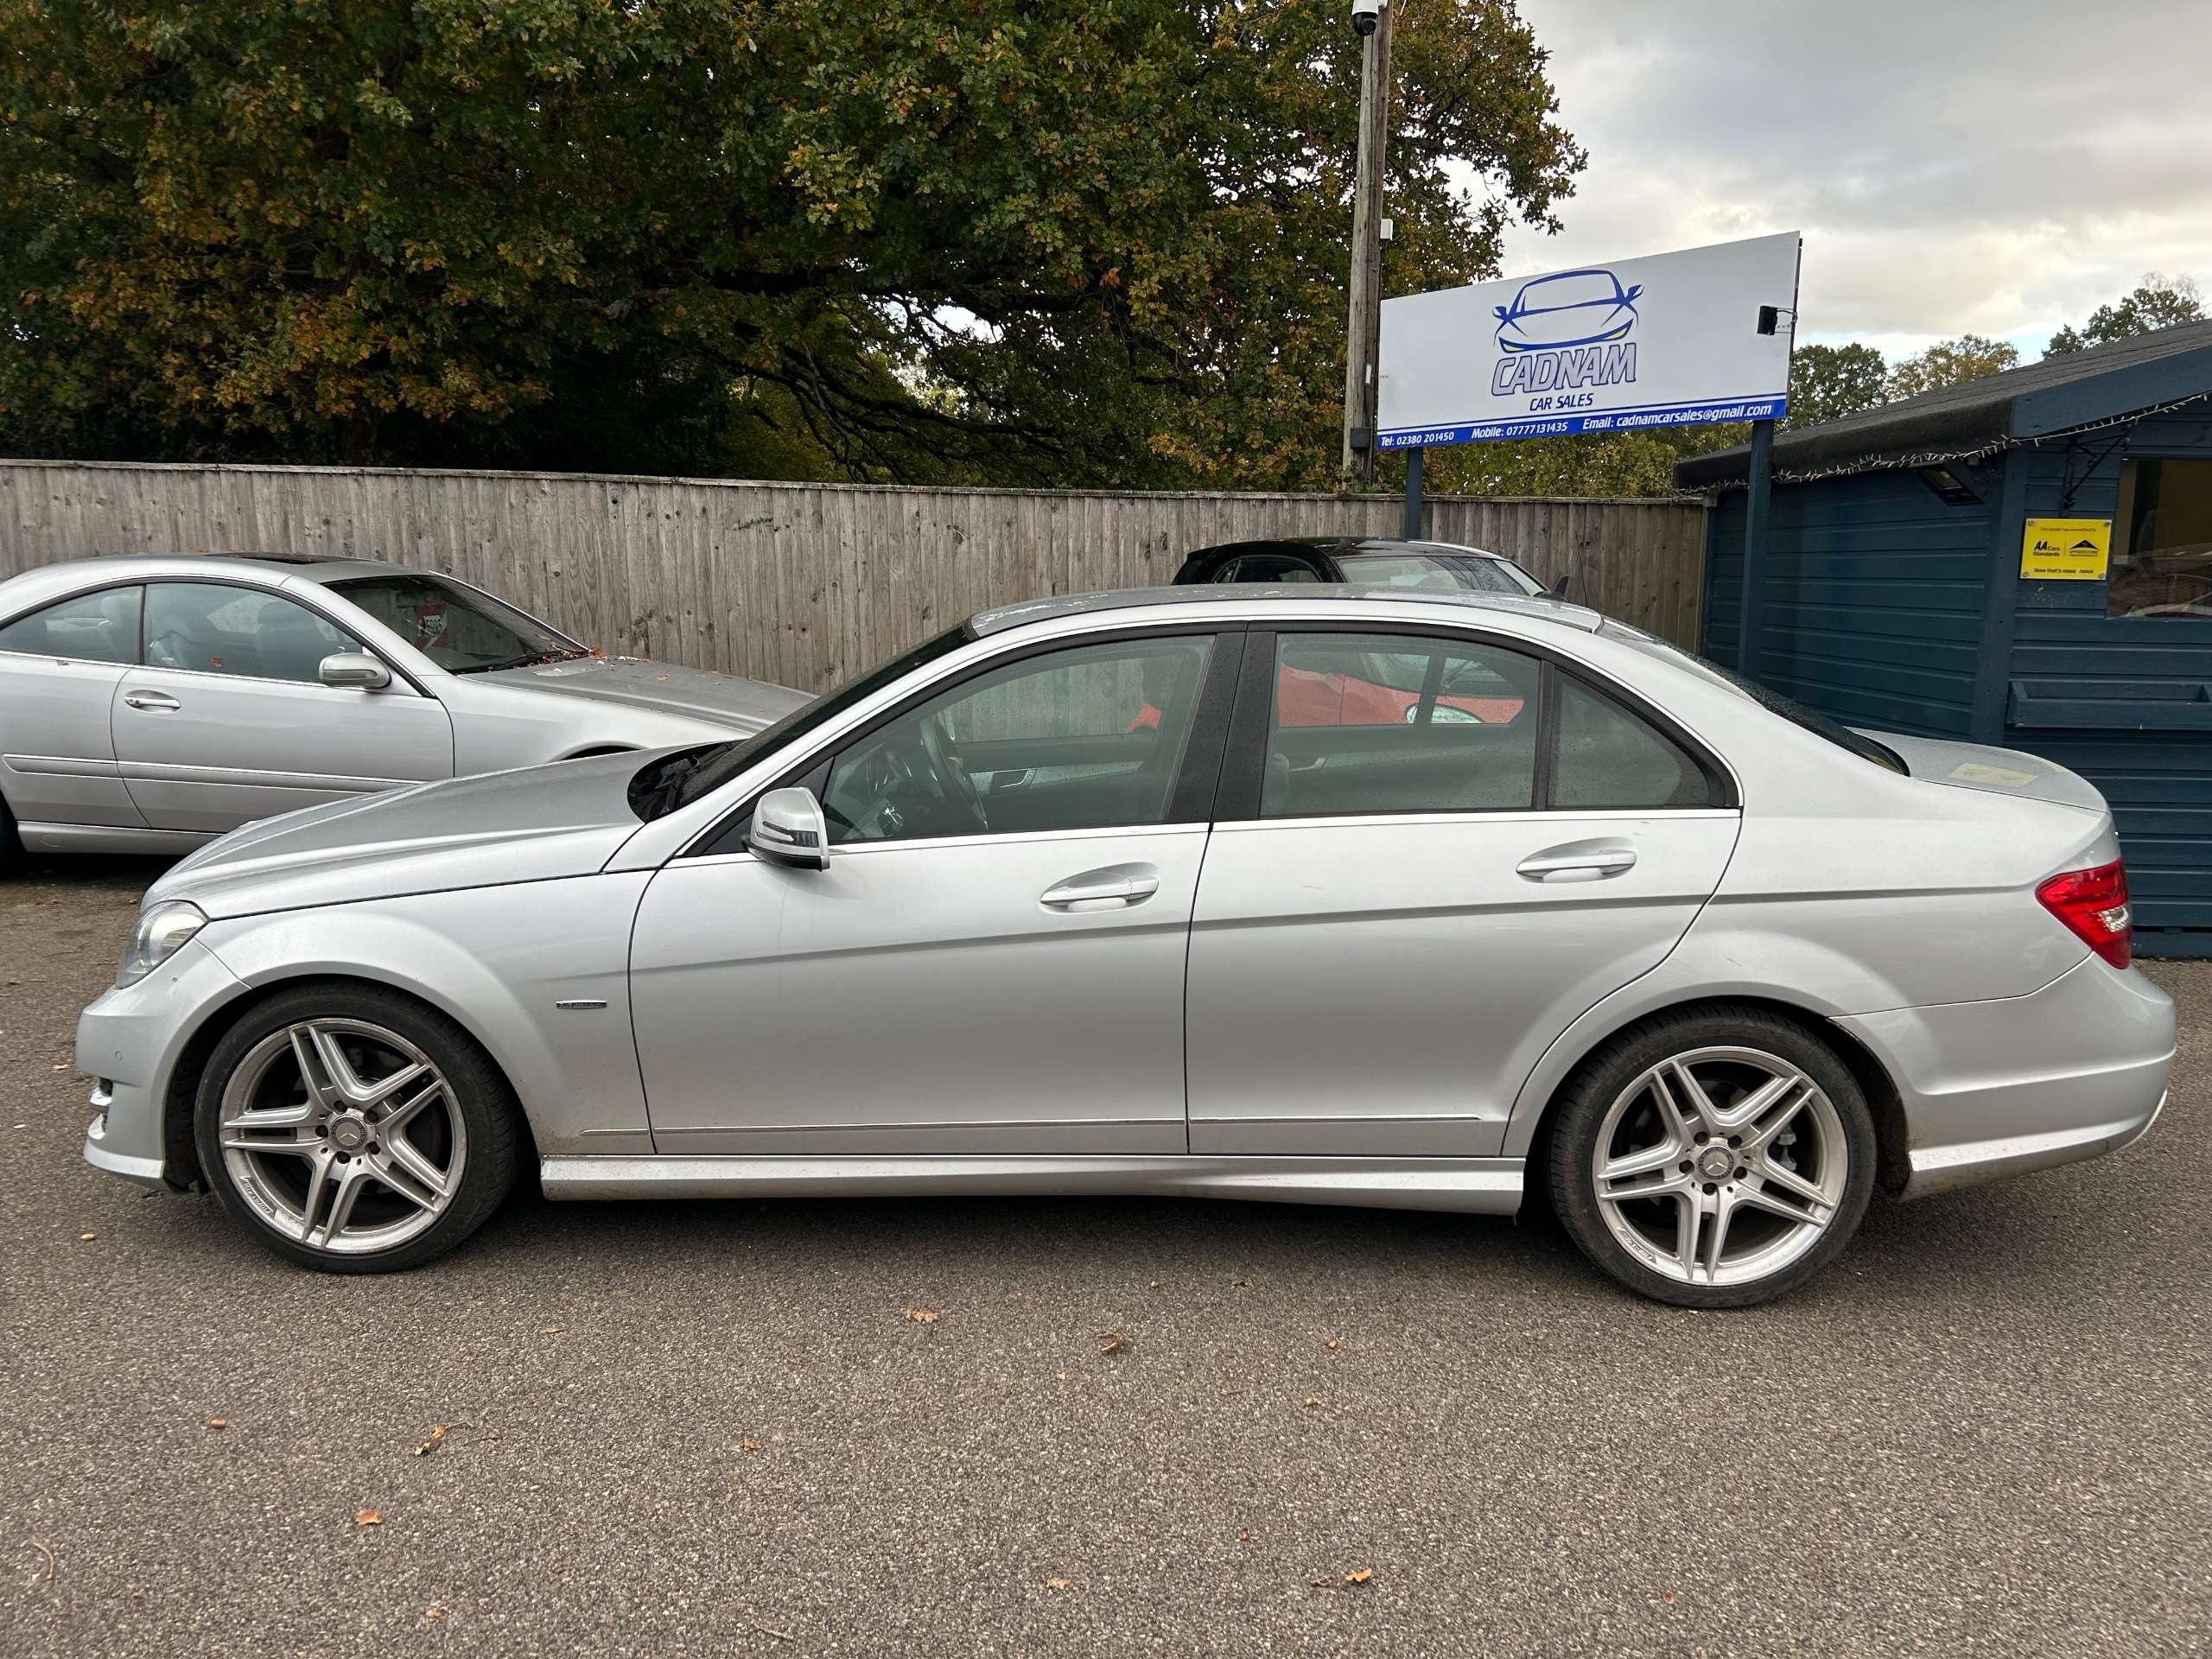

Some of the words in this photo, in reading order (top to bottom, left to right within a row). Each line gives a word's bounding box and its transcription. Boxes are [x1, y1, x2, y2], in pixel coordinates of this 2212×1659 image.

[1491, 342, 1637, 397] CADNAM
[1529, 397, 1553, 411] CAR
[1556, 393, 1594, 409] SALES
[1582, 416, 1614, 430] Email:
[1616, 404, 1772, 427] cadnamcarsales@gmail.com
[1381, 436, 1395, 447] Tel:
[1396, 435, 1422, 446] 02380
[1424, 431, 1455, 443] 201450
[1471, 427, 1504, 439] Mobile:
[1506, 422, 1568, 436] 07777131435
[2033, 541, 2048, 551] AA
